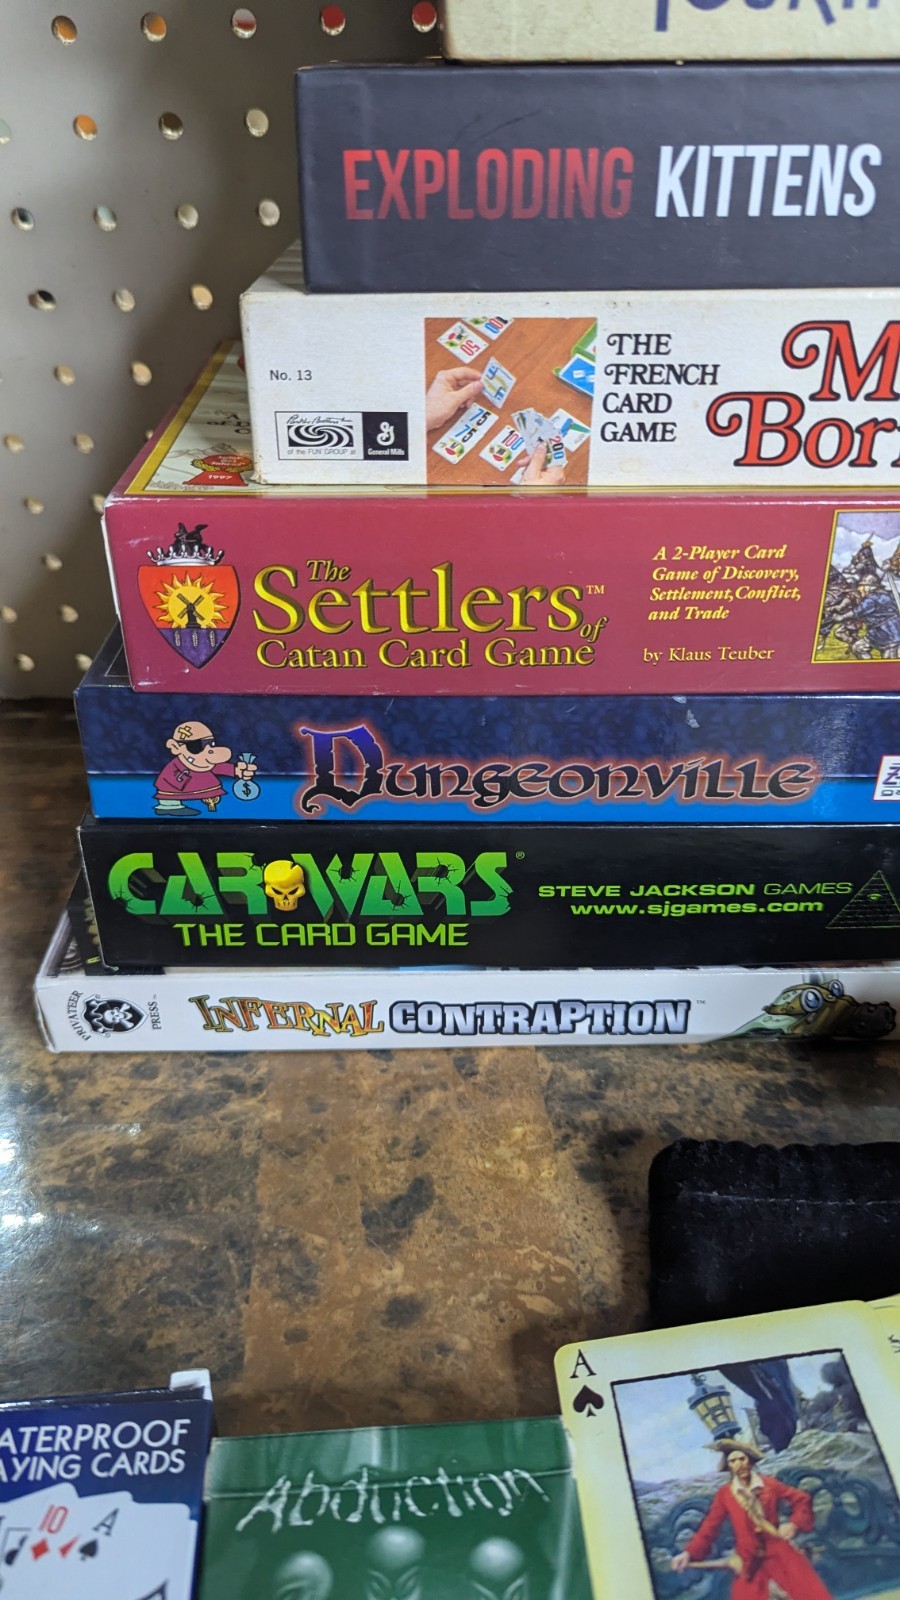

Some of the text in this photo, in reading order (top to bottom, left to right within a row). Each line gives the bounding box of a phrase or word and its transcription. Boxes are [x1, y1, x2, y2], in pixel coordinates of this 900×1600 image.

[342, 143, 882, 221] EXPLODING KITTENS
[606, 333, 672, 356] THE
[269, 369, 313, 381] No. 13
[604, 363, 721, 386] FRENCH
[602, 392, 673, 414] CARD
[469, 408, 491, 426] 75
[454, 424, 478, 443] 75
[501, 430, 525, 451] 100
[599, 421, 678, 443] GAME
[706, 391, 900, 469] Bor
[367, 448, 391, 456] General
[652, 544, 788, 563] A 2-Player Card
[306, 559, 351, 582] The
[652, 565, 799, 583] Game of Discovery,
[252, 560, 584, 635] Settlers
[650, 585, 801, 603] Settlement, Conflict,
[647, 606, 730, 621] and Trade
[579, 616, 609, 643] of
[256, 637, 596, 669] Catan Card Game
[643, 646, 775, 665] by Klaus Teuber
[108, 851, 513, 917] CAR WARS
[538, 882, 853, 898] STEVE JACKSON GAMES
[570, 900, 824, 917] www.sjgames.com
[172, 923, 470, 947] THE CARD GAME
[67, 990, 92, 1041] PRIVATEER
[148, 1000, 162, 1030] PRESS
[189, 994, 385, 1036] INFERNAL
[389, 1000, 691, 1035] CONTRAPTION
[569, 1349, 596, 1379] A
[91, 1449, 186, 1478] CARDS
[235, 1466, 550, 1533] Abduction
[38, 1503, 69, 1535] 10
[93, 1507, 120, 1537] A
